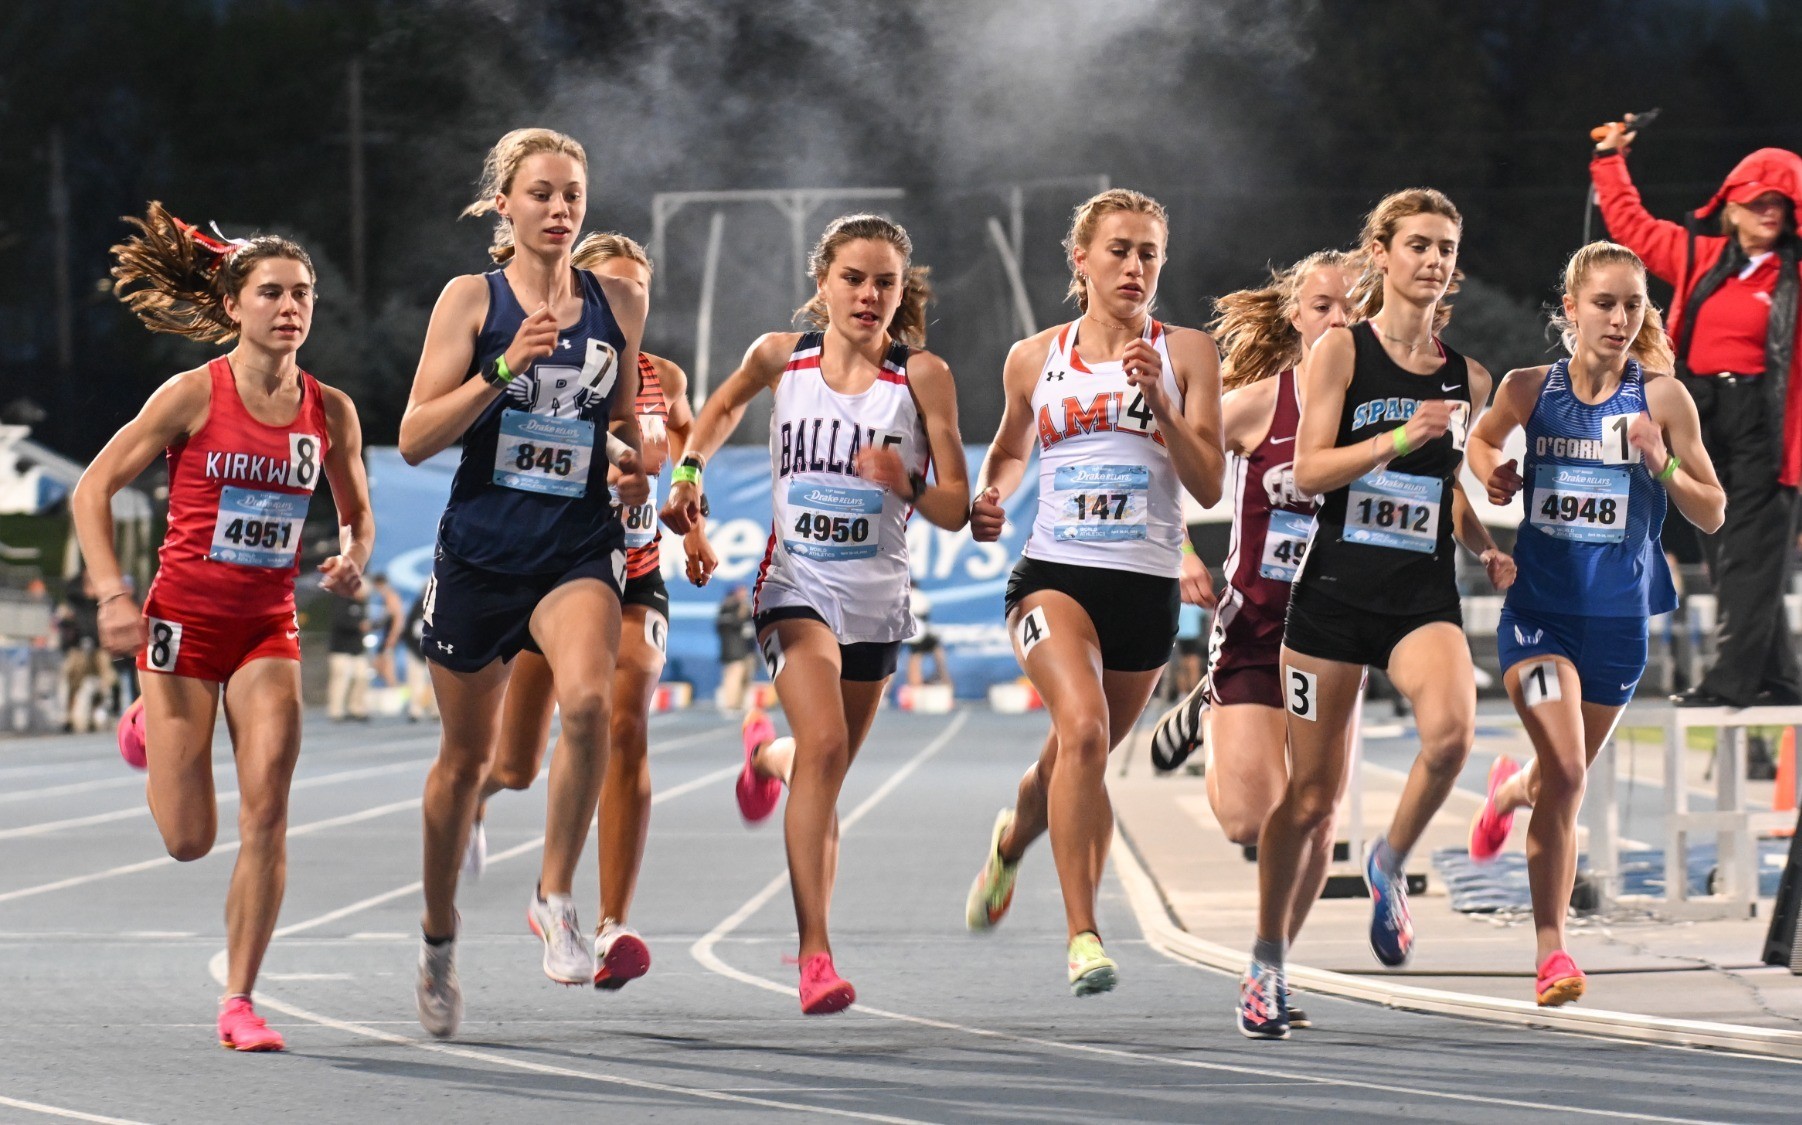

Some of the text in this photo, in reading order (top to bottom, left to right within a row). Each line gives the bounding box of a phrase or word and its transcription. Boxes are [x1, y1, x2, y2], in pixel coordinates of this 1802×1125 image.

[1127, 391, 1154, 430] 4
[1351, 397, 1423, 432] SPAR
[779, 418, 876, 479] BALLA
[1611, 416, 1629, 461] 1
[296, 437, 315, 486] 8
[515, 443, 573, 477] 845
[1559, 471, 1587, 483] Drake
[810, 489, 839, 503] Drake
[838, 498, 864, 506] RELAYS
[1073, 494, 1128, 520] 147
[1541, 494, 1617, 525] 4948
[794, 512, 869, 543] 4950
[1358, 498, 1430, 533] 1812
[224, 518, 292, 549] 4951
[151, 622, 173, 667] 8
[1023, 613, 1043, 647] 4
[1291, 671, 1309, 716] 3
[1529, 663, 1548, 696] 1
